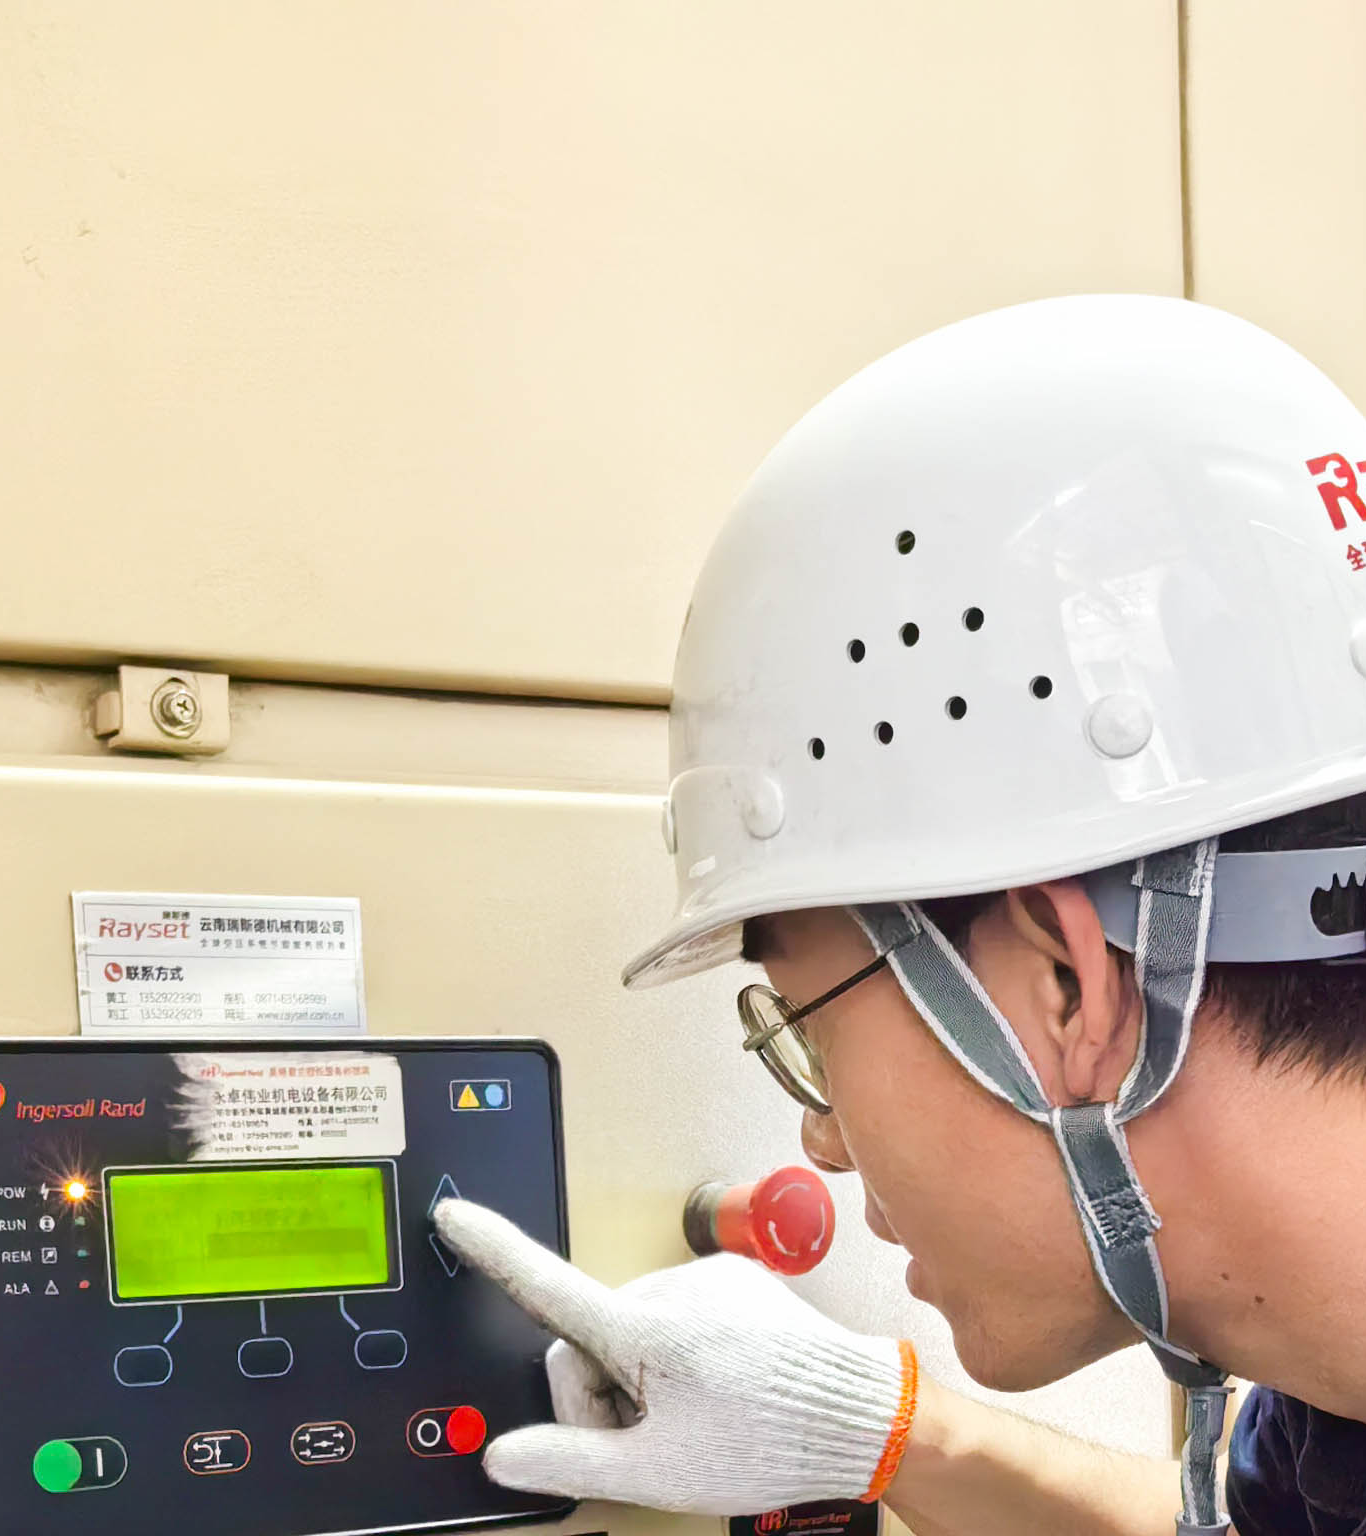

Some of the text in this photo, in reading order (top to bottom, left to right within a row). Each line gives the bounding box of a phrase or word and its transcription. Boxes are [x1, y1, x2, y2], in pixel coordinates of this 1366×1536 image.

[98, 917, 190, 941] Rayset
[199, 917, 345, 935] 云南瑞斯德机械有限公司
[125, 965, 185, 982] 联系方式
[16, 1098, 146, 1122] Ingersoll Rand
[1, 1251, 32, 1263] REM
[4, 1284, 30, 1295] ALA
